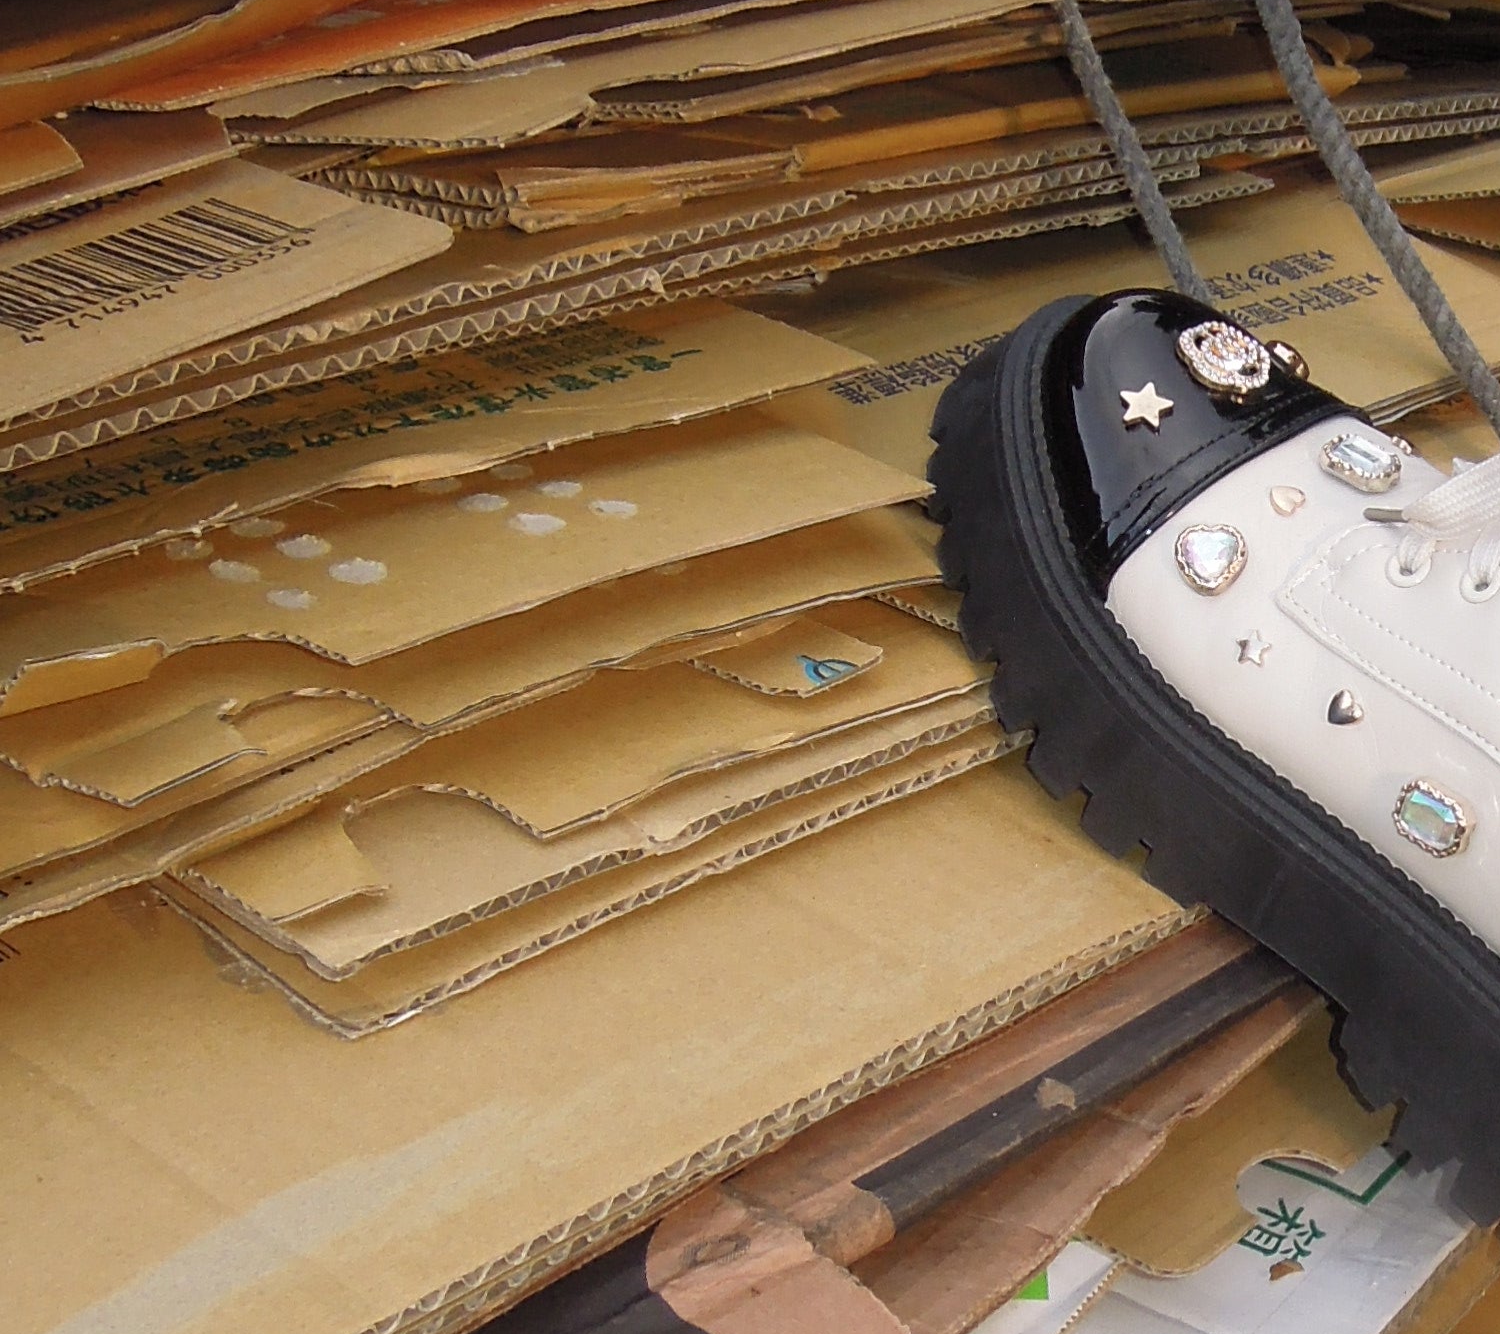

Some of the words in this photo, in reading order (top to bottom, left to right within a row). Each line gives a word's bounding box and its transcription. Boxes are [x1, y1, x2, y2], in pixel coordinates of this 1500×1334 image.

[54, 282, 178, 330] 714947
[196, 237, 312, 281] 000356
[1236, 1196, 1327, 1262] 箱
